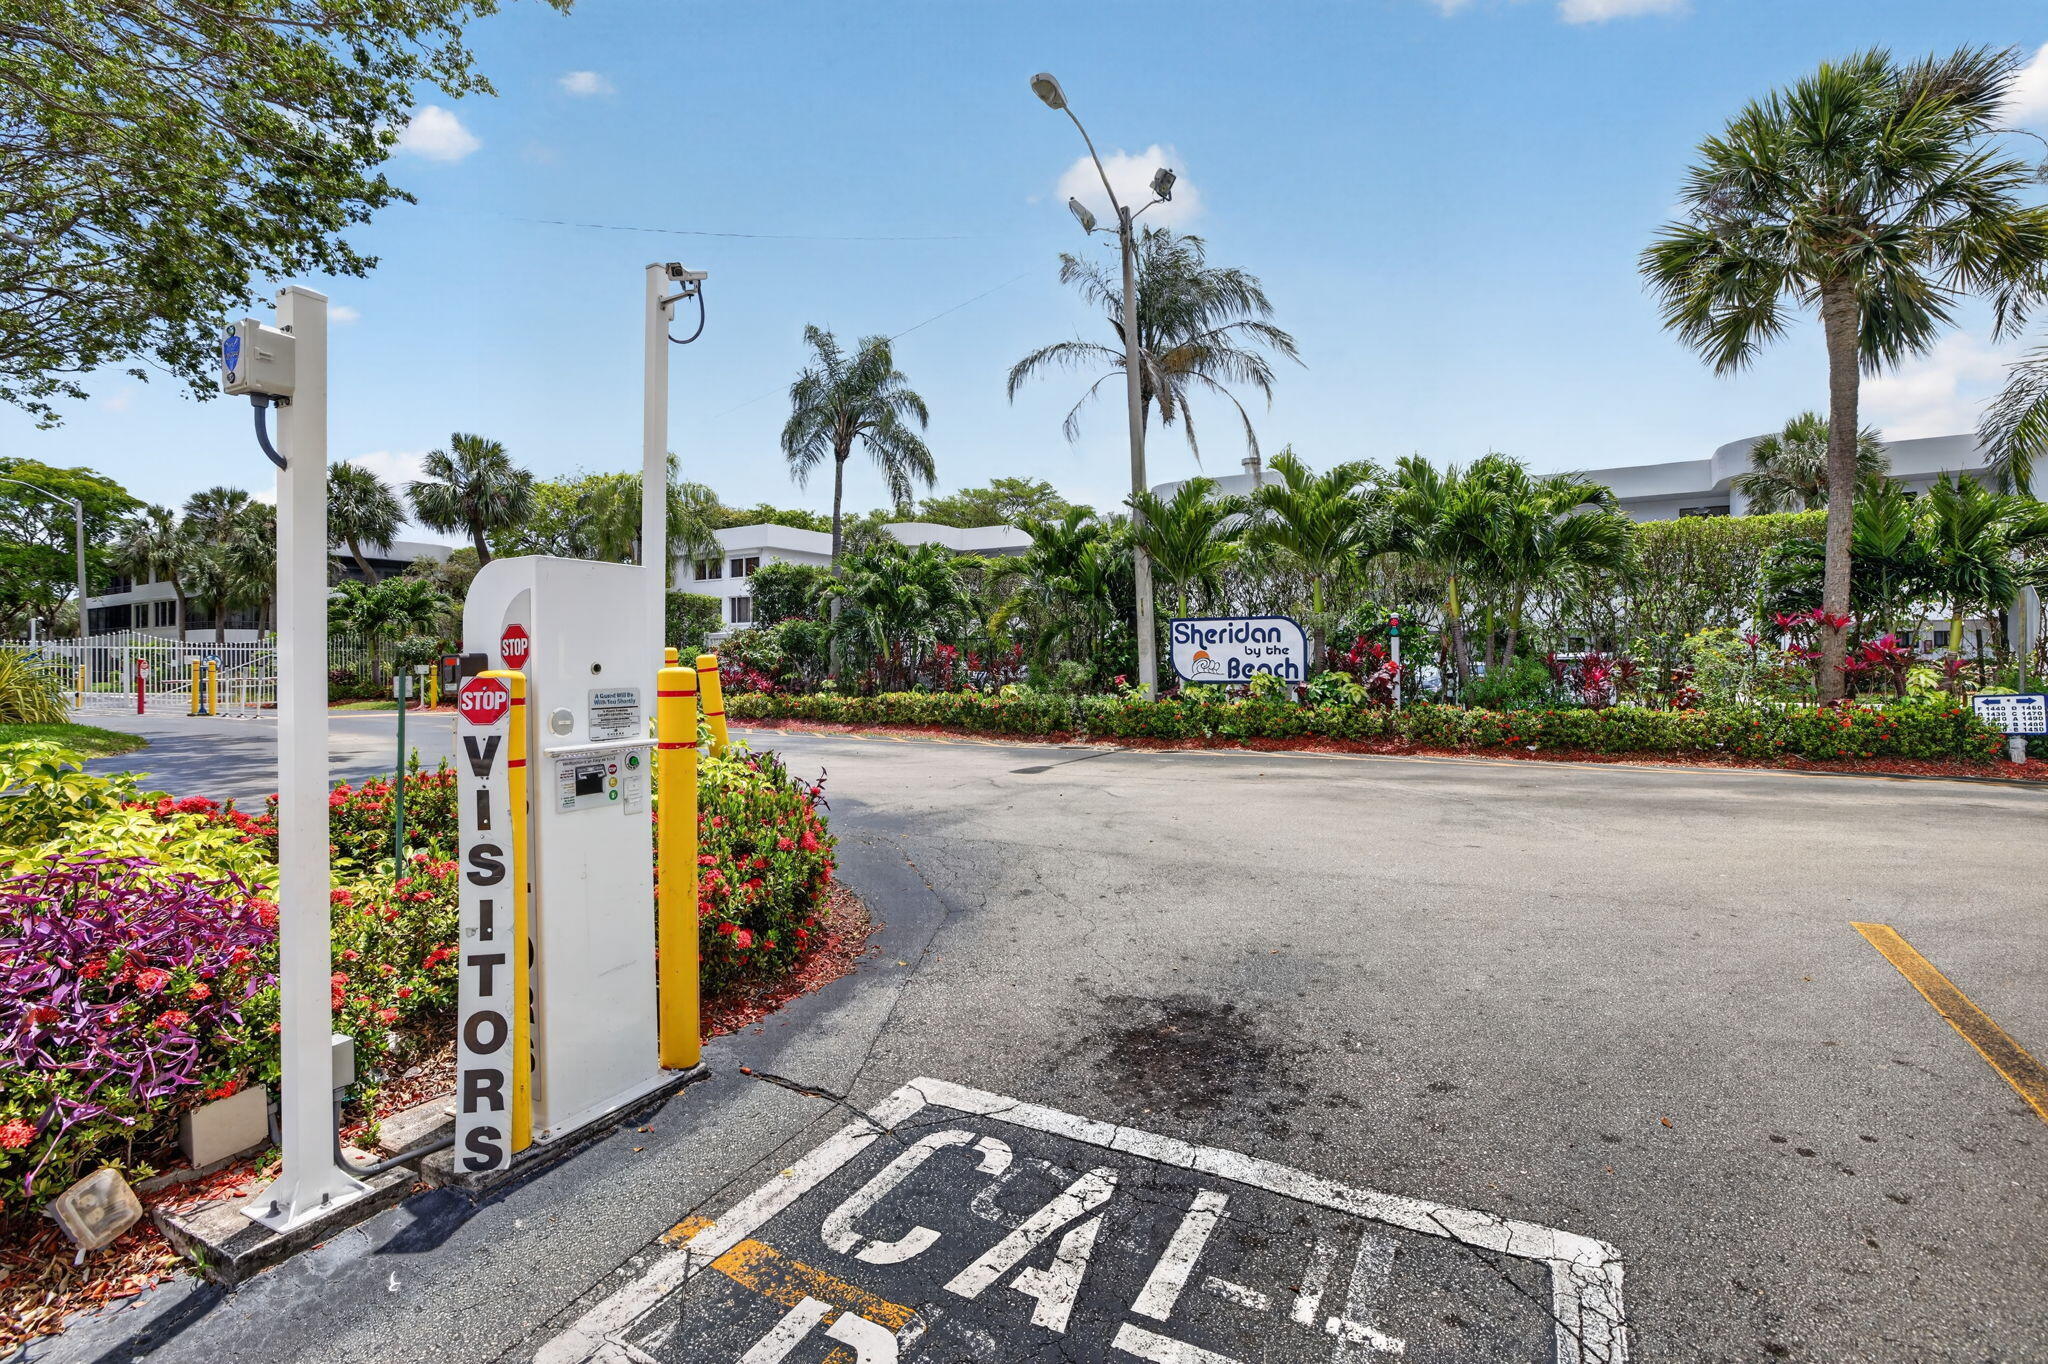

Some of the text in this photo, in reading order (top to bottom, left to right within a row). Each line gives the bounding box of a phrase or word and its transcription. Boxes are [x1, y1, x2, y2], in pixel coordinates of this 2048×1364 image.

[1174, 622, 1281, 650] Sheridan
[502, 638, 528, 656] STOP
[1245, 645, 1290, 658] by the
[1227, 657, 1299, 679] Beach
[461, 691, 507, 711] STOP
[463, 735, 509, 1172] VISITORS
